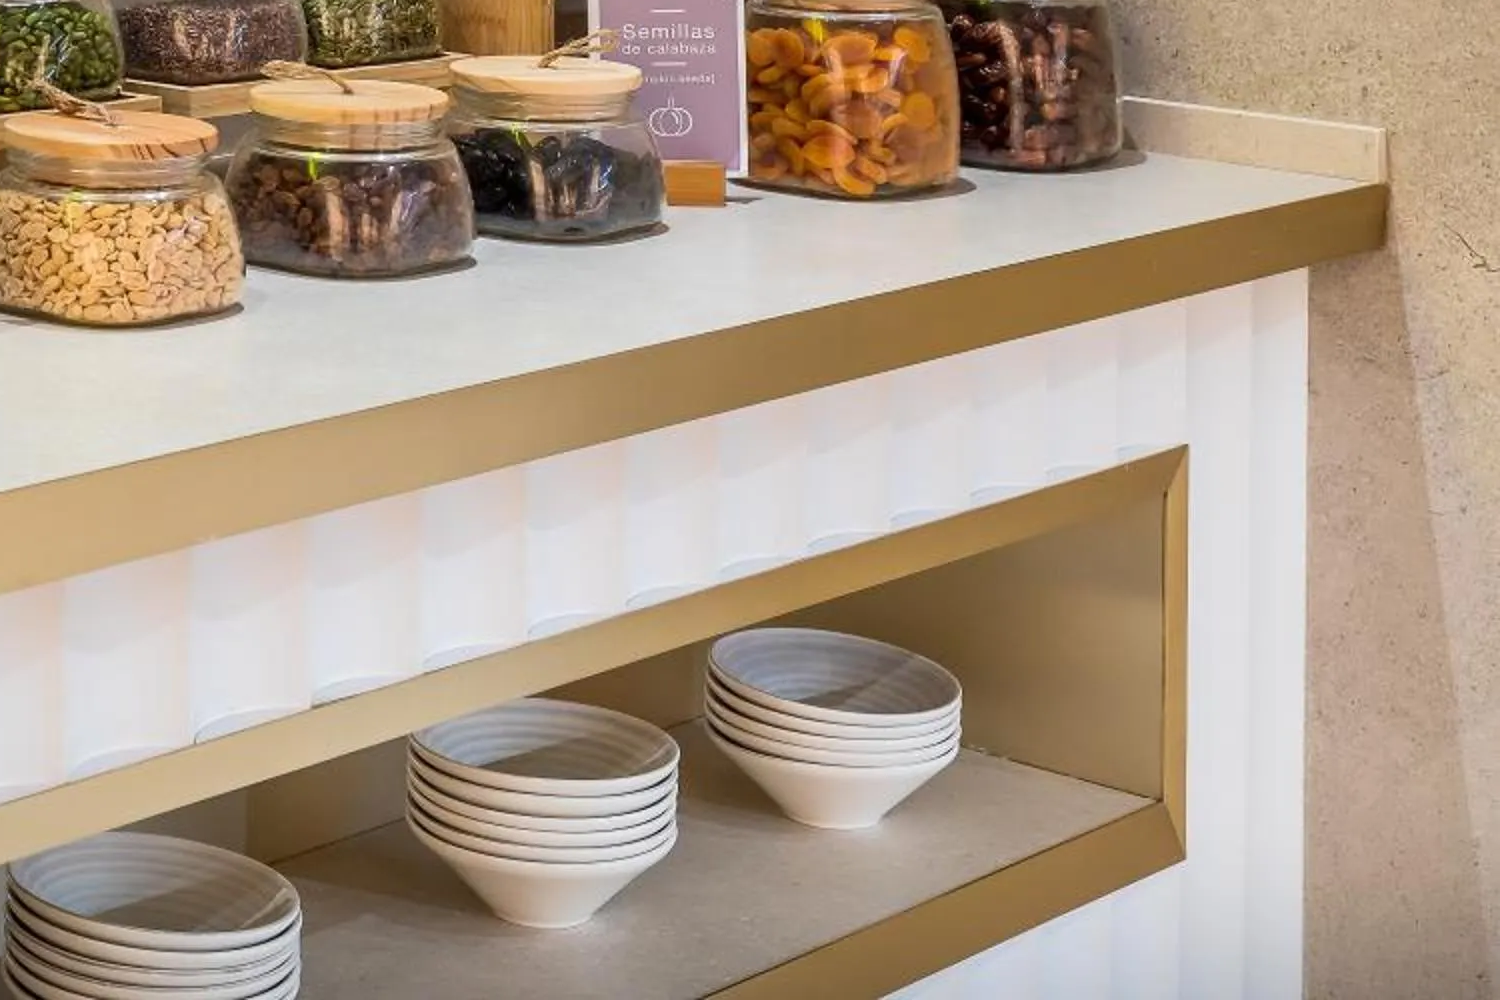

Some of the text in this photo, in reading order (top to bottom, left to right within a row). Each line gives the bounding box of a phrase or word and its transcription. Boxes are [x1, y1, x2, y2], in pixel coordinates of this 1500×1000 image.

[623, 23, 715, 40] Semillas
[621, 42, 716, 55] de calabaza
